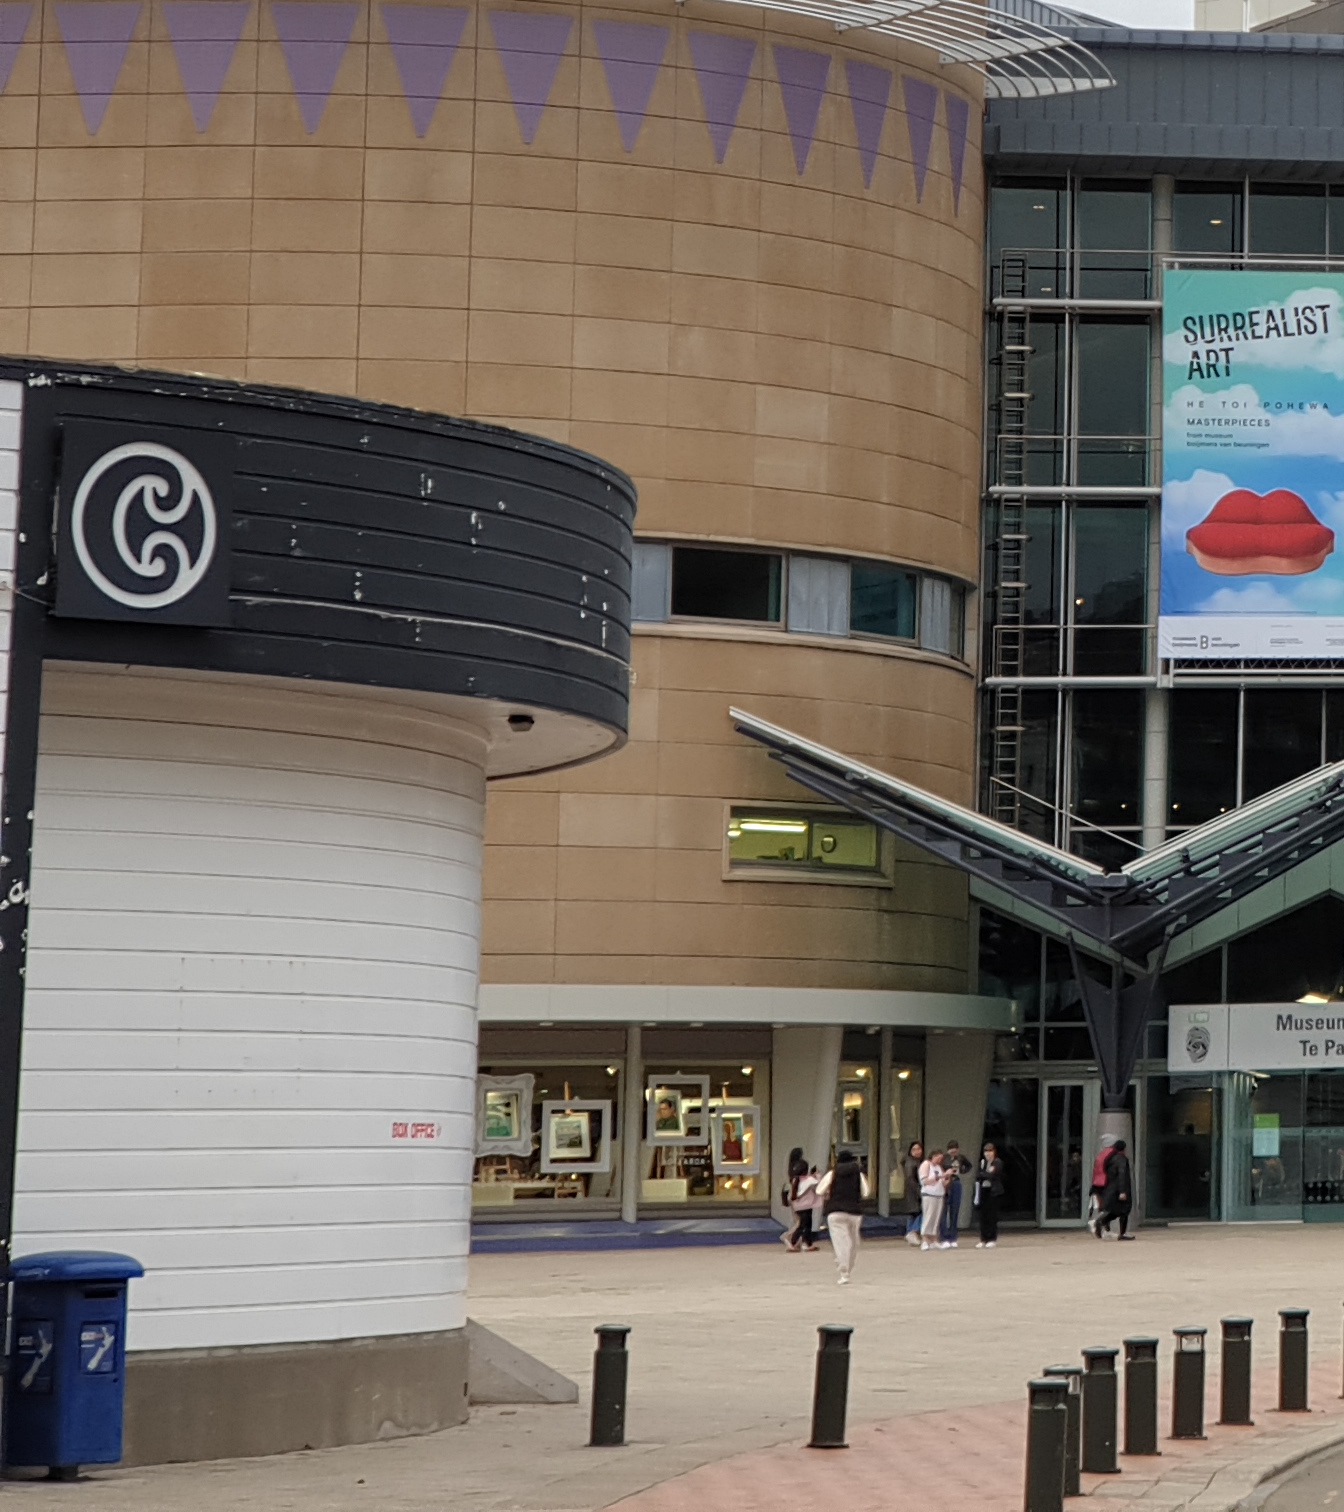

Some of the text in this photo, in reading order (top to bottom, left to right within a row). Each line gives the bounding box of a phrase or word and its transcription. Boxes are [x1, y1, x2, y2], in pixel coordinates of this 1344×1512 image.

[1183, 304, 1331, 346] SURREALIST
[1187, 347, 1234, 380] ART
[1187, 401, 1329, 410] HE TOI POHEWA
[1187, 418, 1271, 427] MASTERPIECES
[1299, 1039, 1319, 1057] Te
